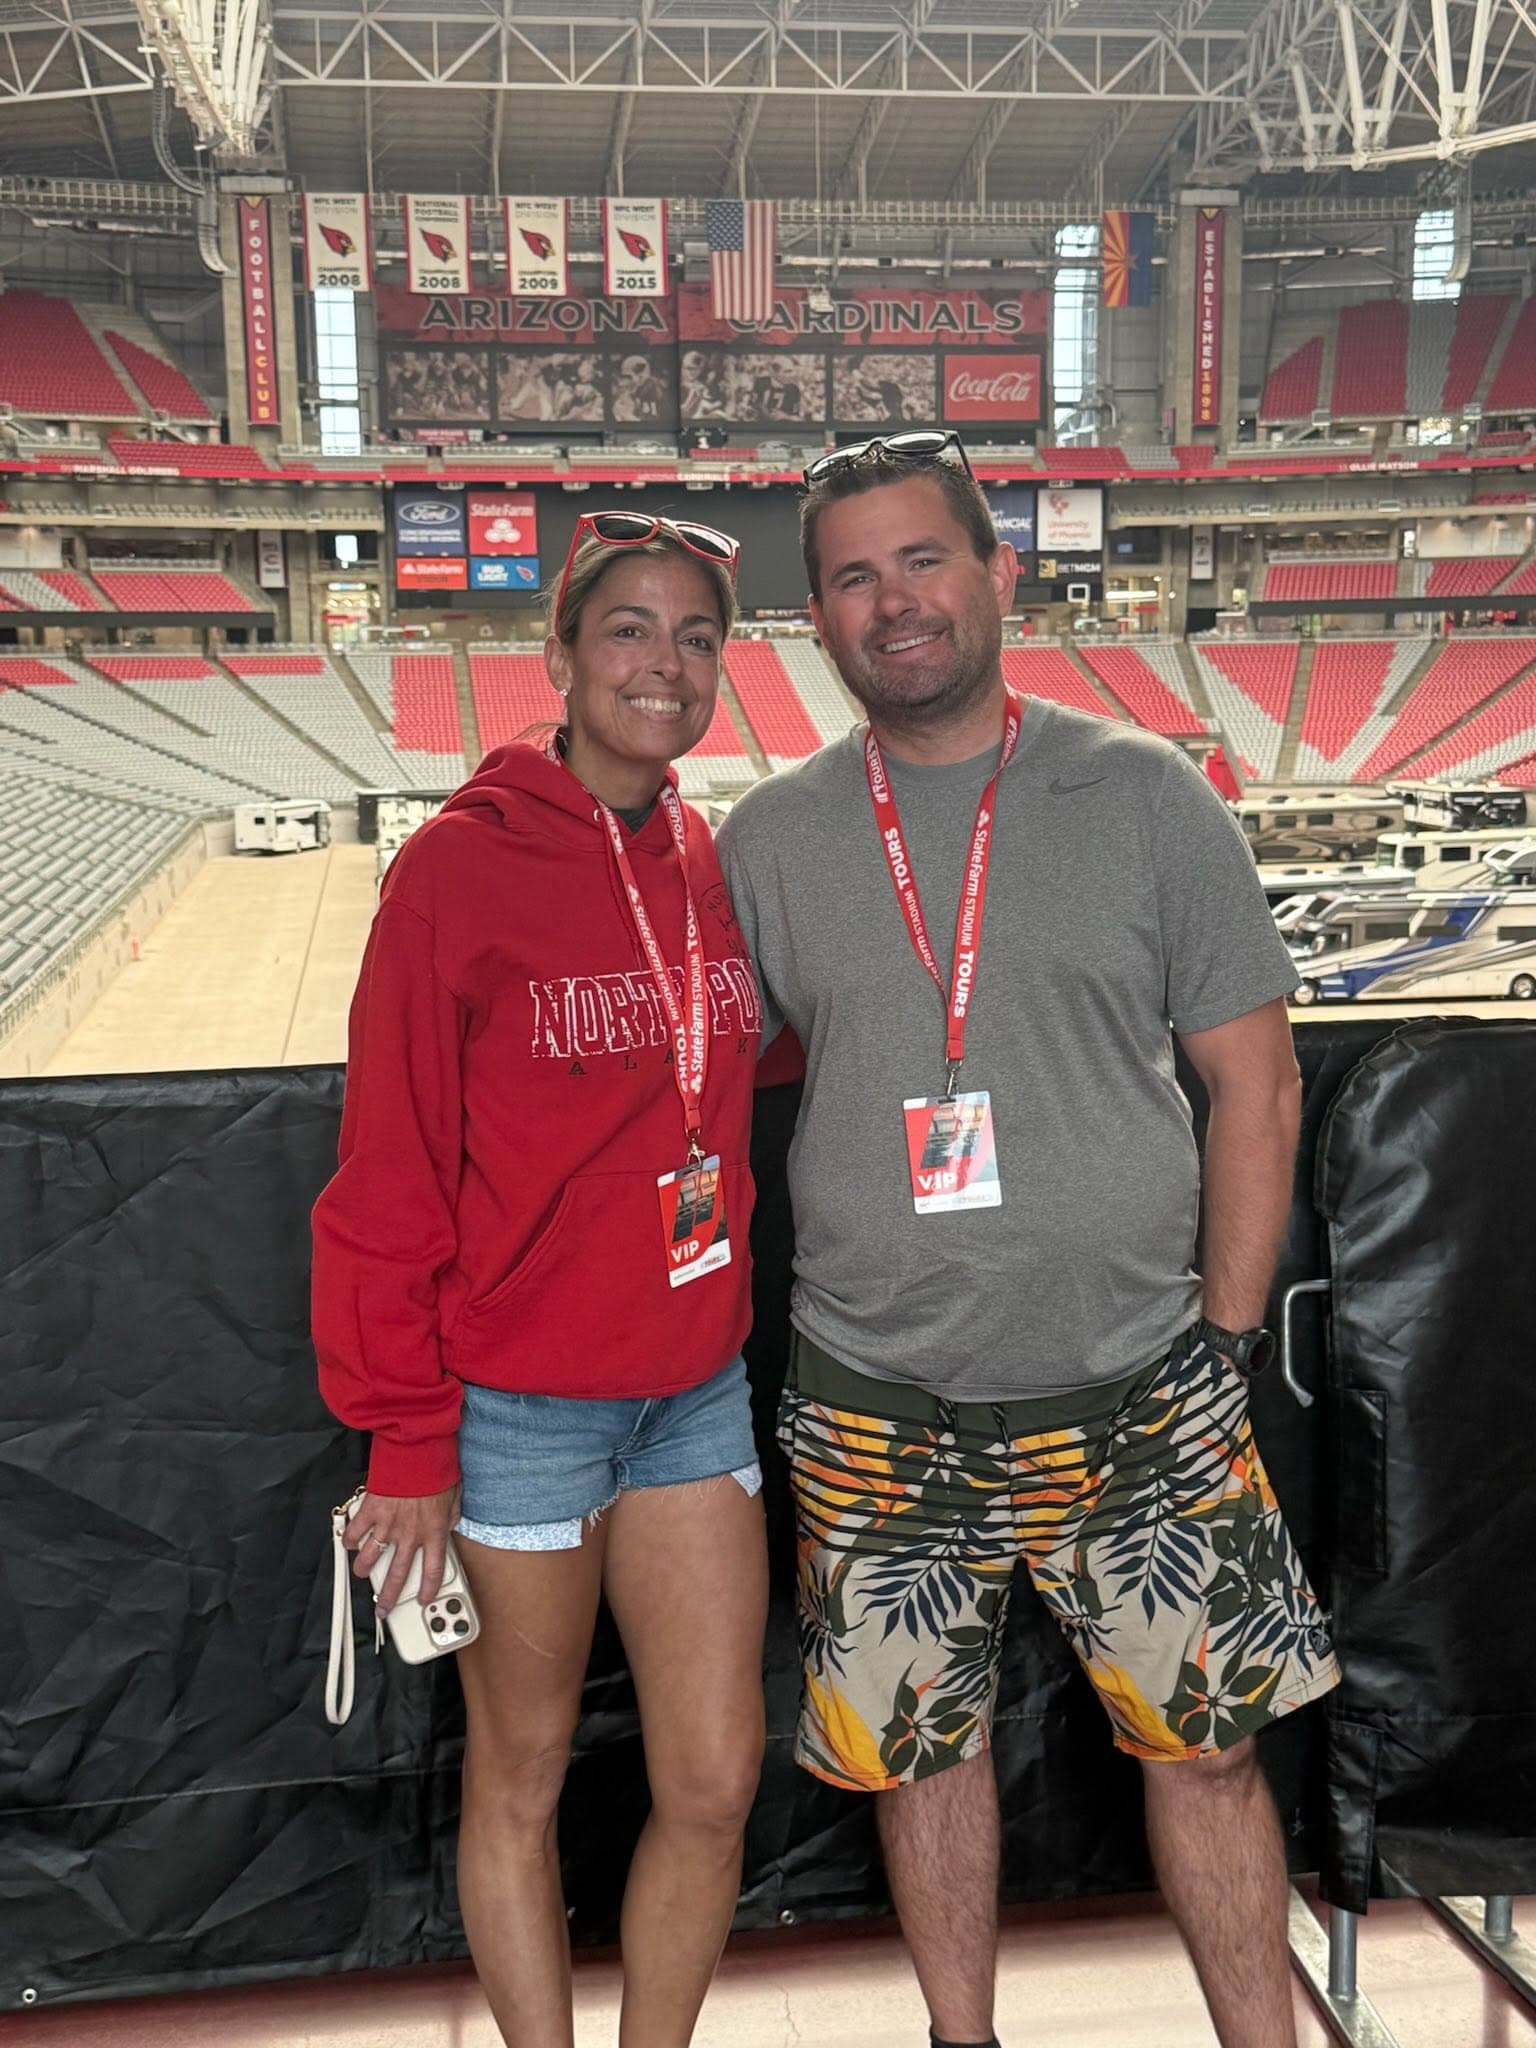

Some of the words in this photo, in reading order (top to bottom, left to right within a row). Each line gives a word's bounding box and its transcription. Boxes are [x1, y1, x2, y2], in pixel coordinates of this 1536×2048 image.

[248, 218, 267, 351] FOOTBALL
[317, 274, 361, 286] 2008
[418, 276, 461, 288] 2008
[518, 278, 558, 289] 2009
[616, 277, 657, 289] 2015
[1201, 230, 1216, 370] ESTABLISHED
[419, 296, 669, 332] ARIZONA
[255, 355, 271, 418] CLUB
[410, 504, 449, 520] Ford
[991, 517, 1033, 530] ANCIAL
[870, 749, 885, 793] TOURS
[884, 827, 911, 890] TOURS
[904, 890, 923, 936] STADIUM
[960, 897, 976, 947] STADIUM
[657, 973, 680, 1021] STADIUM
[691, 953, 702, 1001] STADIUM
[953, 950, 975, 1019] TOURS
[529, 966, 685, 1058] NORT
[704, 958, 763, 1035] PO
[917, 1170, 958, 1191] VIP
[671, 1240, 700, 1264] VIP
